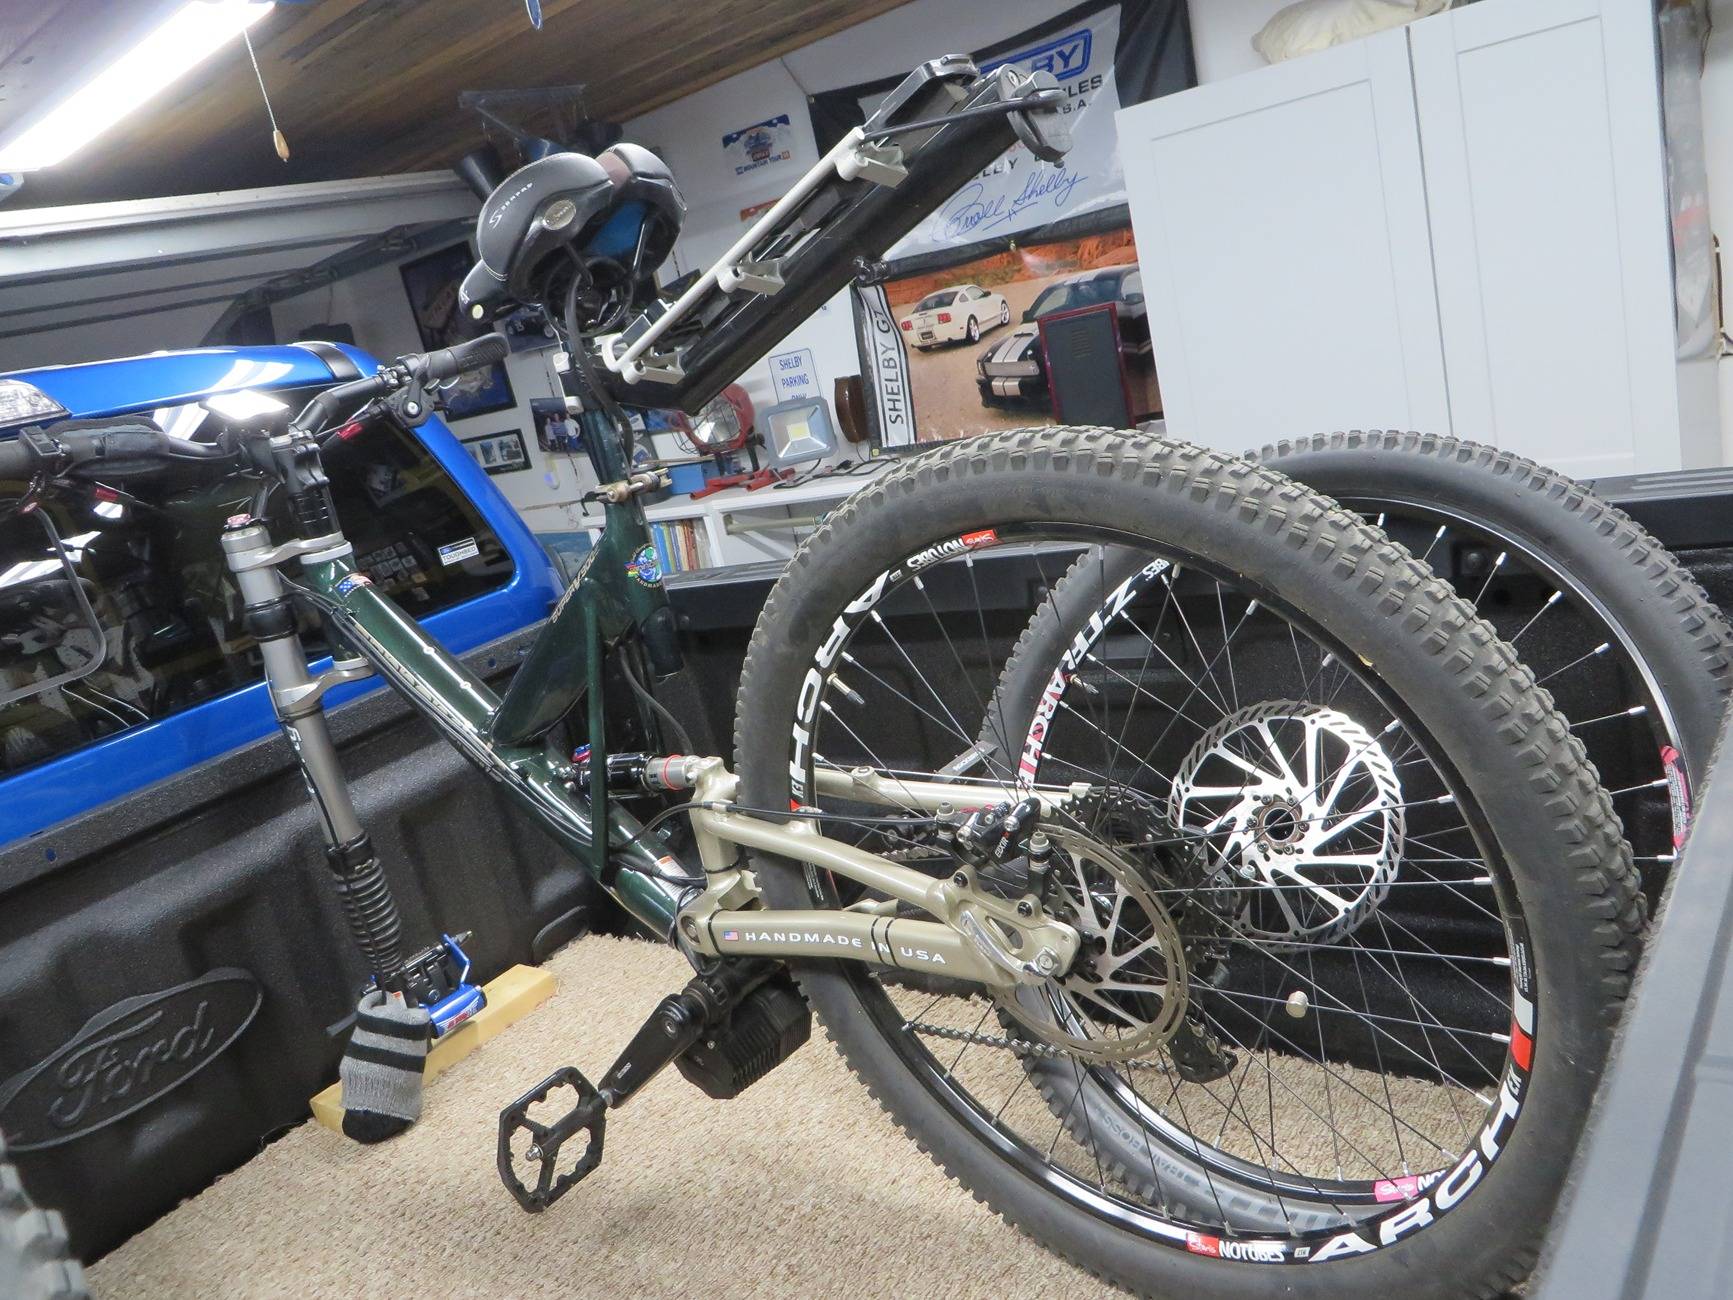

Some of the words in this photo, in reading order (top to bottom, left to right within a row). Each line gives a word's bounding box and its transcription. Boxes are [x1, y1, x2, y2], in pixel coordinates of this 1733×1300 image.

[1063, 74, 1103, 98] LES
[779, 355, 803, 371] SHELBY
[781, 372, 810, 389] PARKING
[882, 343, 904, 425] SHELBY
[789, 569, 890, 784] ARCH
[744, 931, 863, 948] HANDMADE
[870, 940, 891, 954] IN
[900, 946, 947, 965] USA
[50, 1000, 215, 1128] Ford
[1307, 1080, 1521, 1263] ARCH
[1218, 1240, 1287, 1263] NOTUBES
